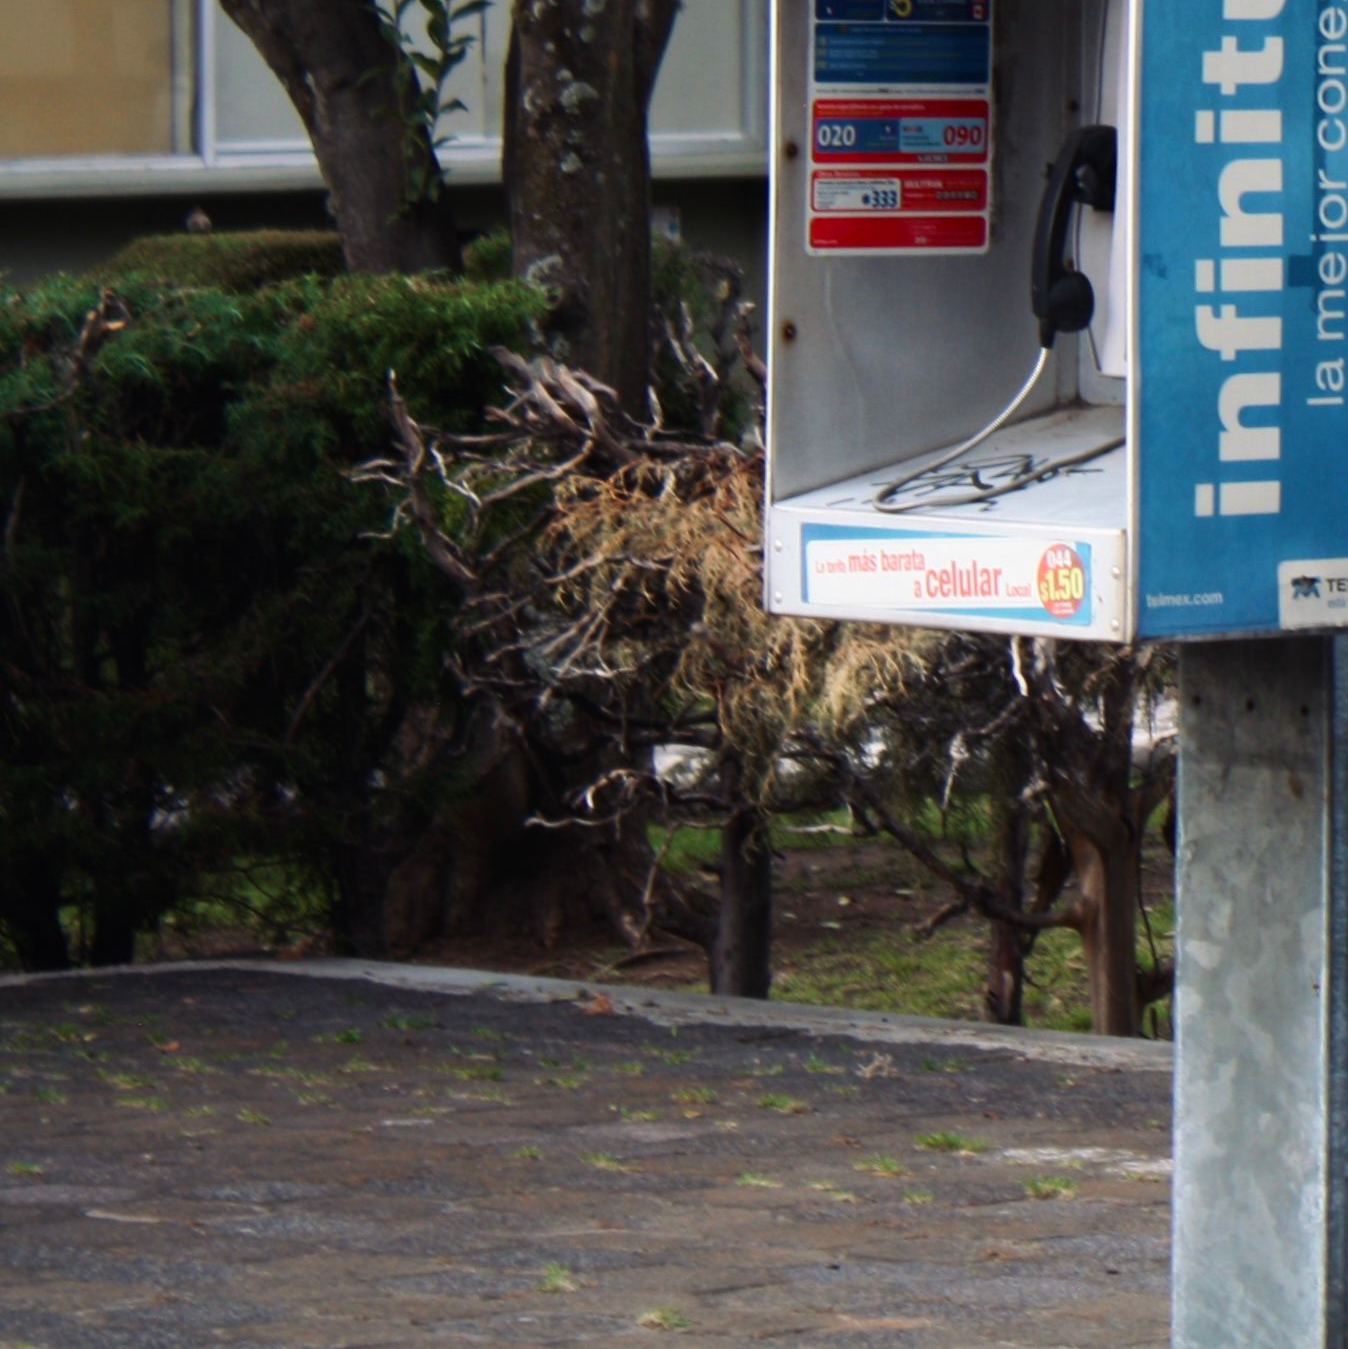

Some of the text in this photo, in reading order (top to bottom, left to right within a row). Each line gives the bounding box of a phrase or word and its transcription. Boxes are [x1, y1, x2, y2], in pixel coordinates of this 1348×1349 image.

[818, 125, 856, 147] 020
[943, 126, 983, 146] 090
[1306, 358, 1345, 406] la
[848, 549, 877, 572] más
[881, 549, 925, 572] barata
[1046, 550, 1072, 568] 044
[914, 580, 922, 597] a
[926, 561, 1002, 598] celular
[1040, 566, 1084, 601] $1.50
[1146, 592, 1224, 608] telmex.com
